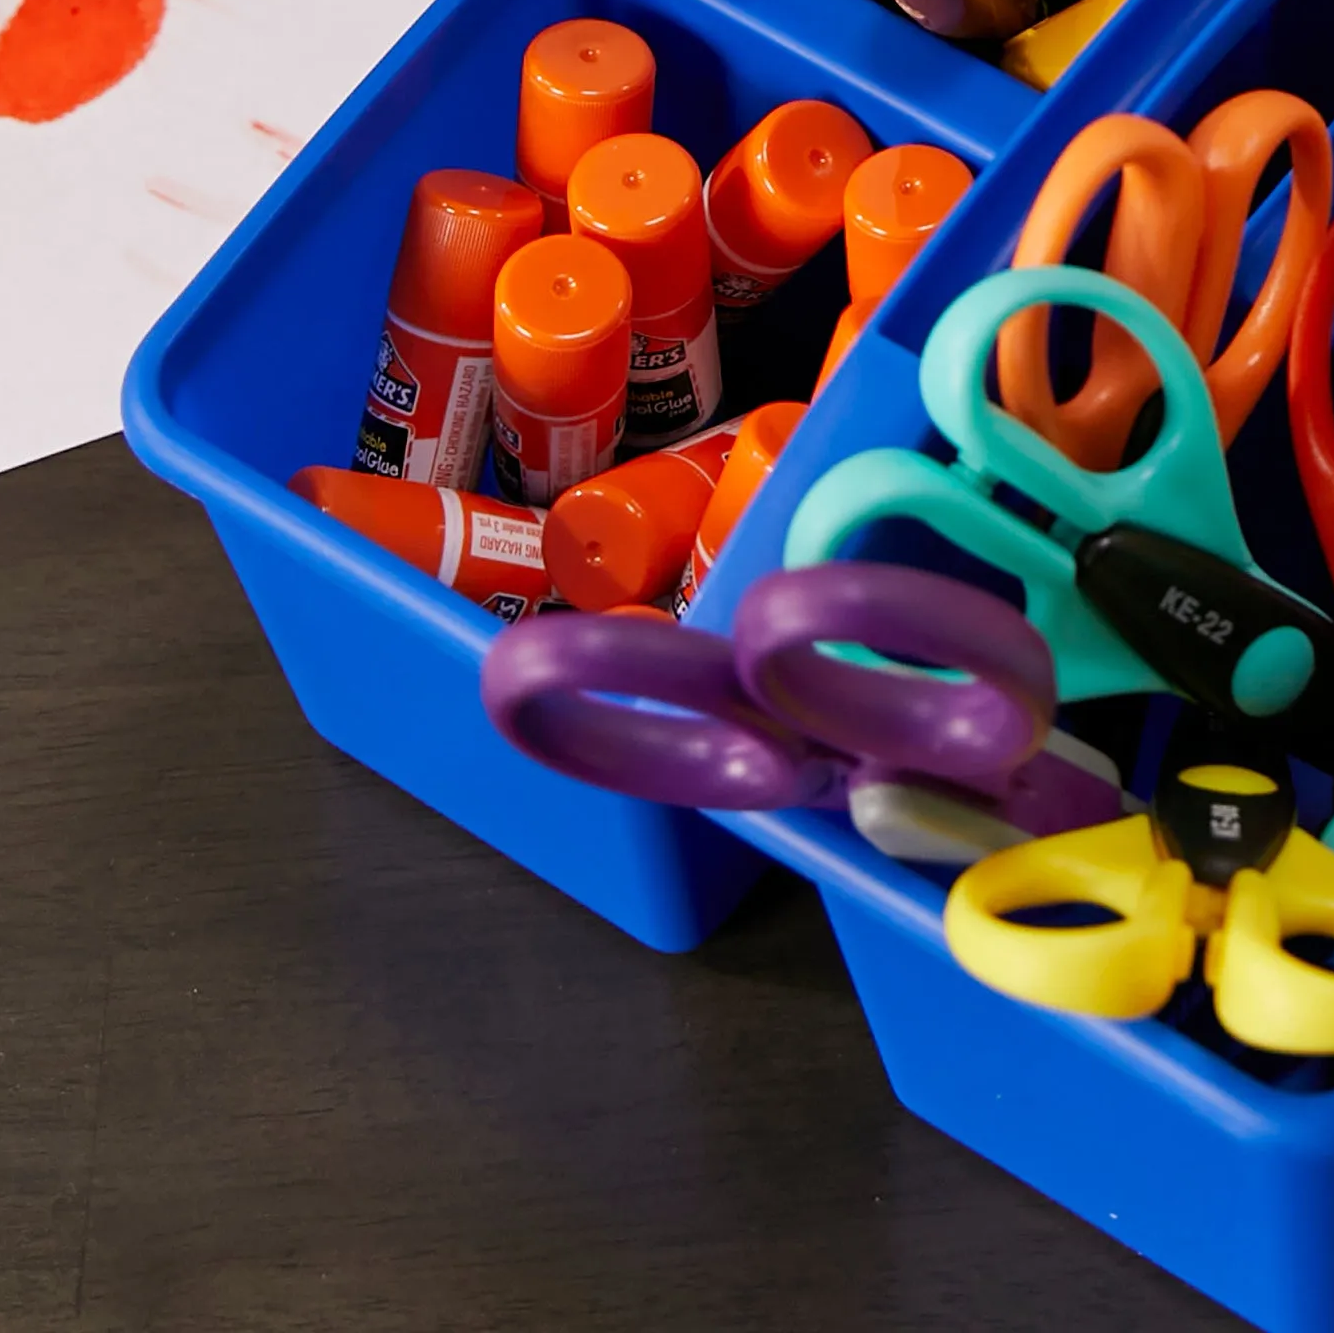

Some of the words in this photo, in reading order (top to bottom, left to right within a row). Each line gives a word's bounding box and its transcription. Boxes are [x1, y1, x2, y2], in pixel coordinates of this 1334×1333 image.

[633, 347, 680, 367] ER'S
[457, 364, 478, 409] HAZARD
[493, 521, 500, 534] 3
[479, 535, 522, 556] HAZARD
[1159, 585, 1234, 646] KE-22
